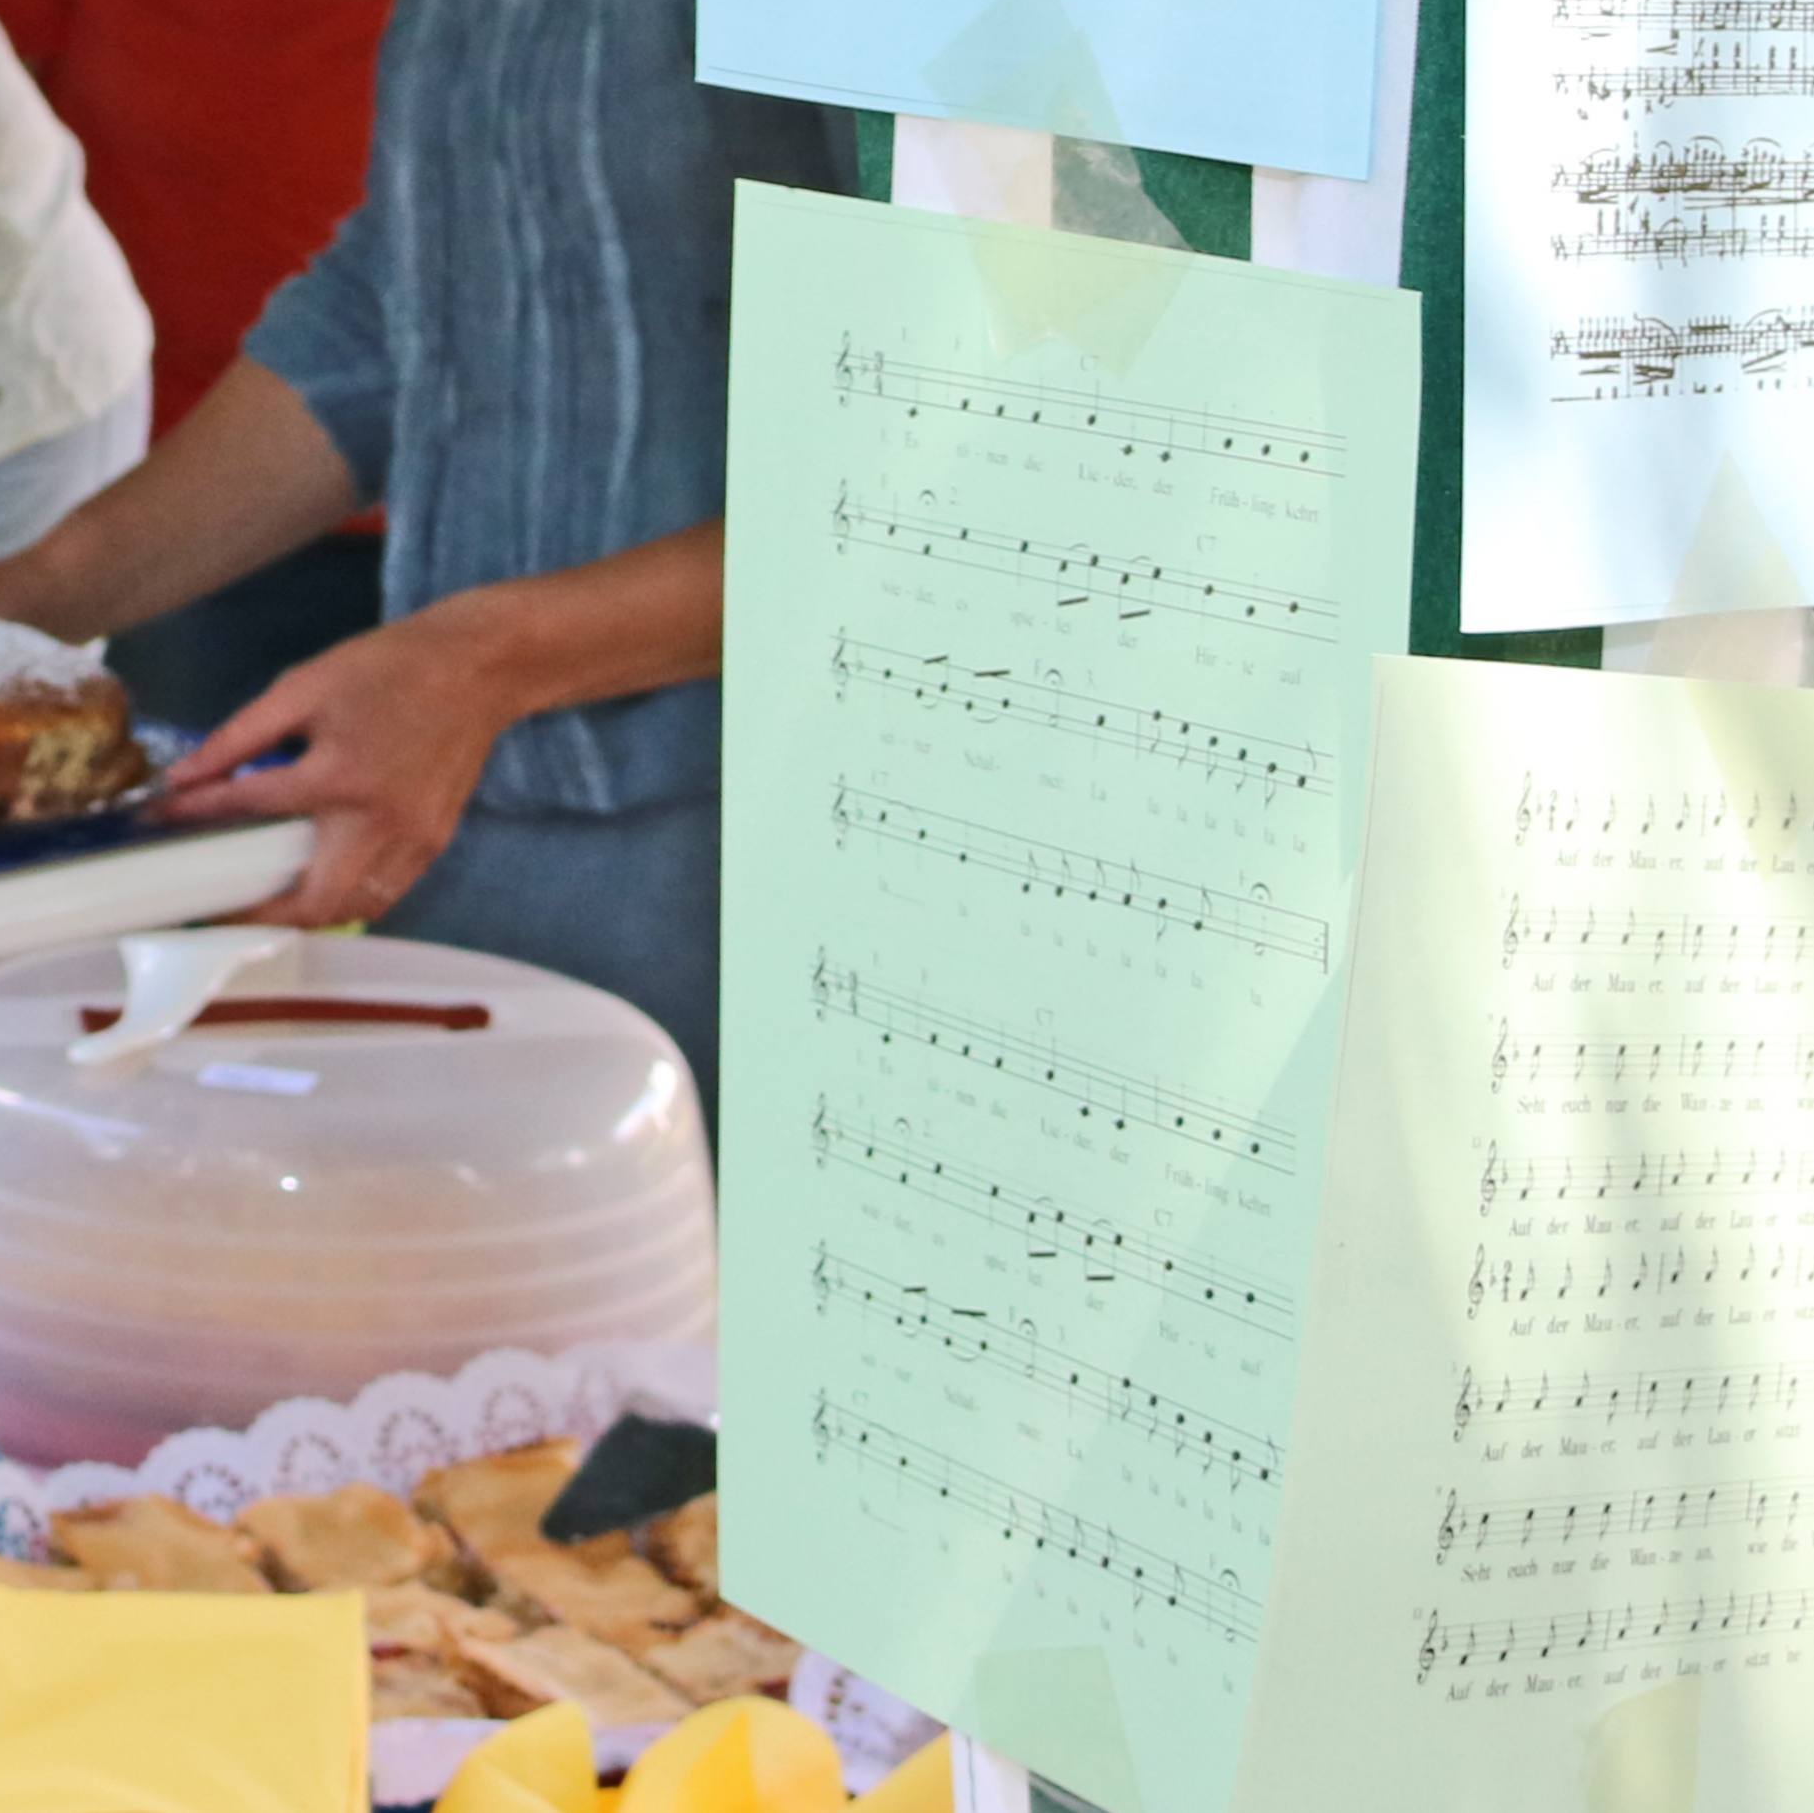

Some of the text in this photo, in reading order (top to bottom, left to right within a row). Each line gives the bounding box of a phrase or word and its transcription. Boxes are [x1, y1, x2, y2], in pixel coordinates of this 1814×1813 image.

[1509, 1217, 1534, 1236] Auf
[1547, 1215, 1569, 1235] der
[1660, 1211, 1683, 1231] auf
[1695, 1212, 1715, 1230] der
[1730, 1210, 1753, 1229] Lau
[1509, 1316, 1535, 1336] Auf
[1547, 1315, 1569, 1335] der
[1660, 1309, 1683, 1328] auf
[1694, 1306, 1714, 1327] der
[1728, 1305, 1751, 1324] Lau
[1481, 1442, 1507, 1462] Auf
[1521, 1441, 1544, 1459] der
[1637, 1431, 1661, 1450] auf
[1673, 1429, 1694, 1447] der
[1707, 1427, 1731, 1445] Lau
[1507, 1559, 1537, 1579] euch
[1552, 1559, 1576, 1575] nur
[1445, 1682, 1472, 1702] Auf
[1486, 1680, 1509, 1698] der
[1603, 1665, 1627, 1685] auf
[1640, 1662, 1662, 1681] der
[1676, 1659, 1702, 1676] Lau
